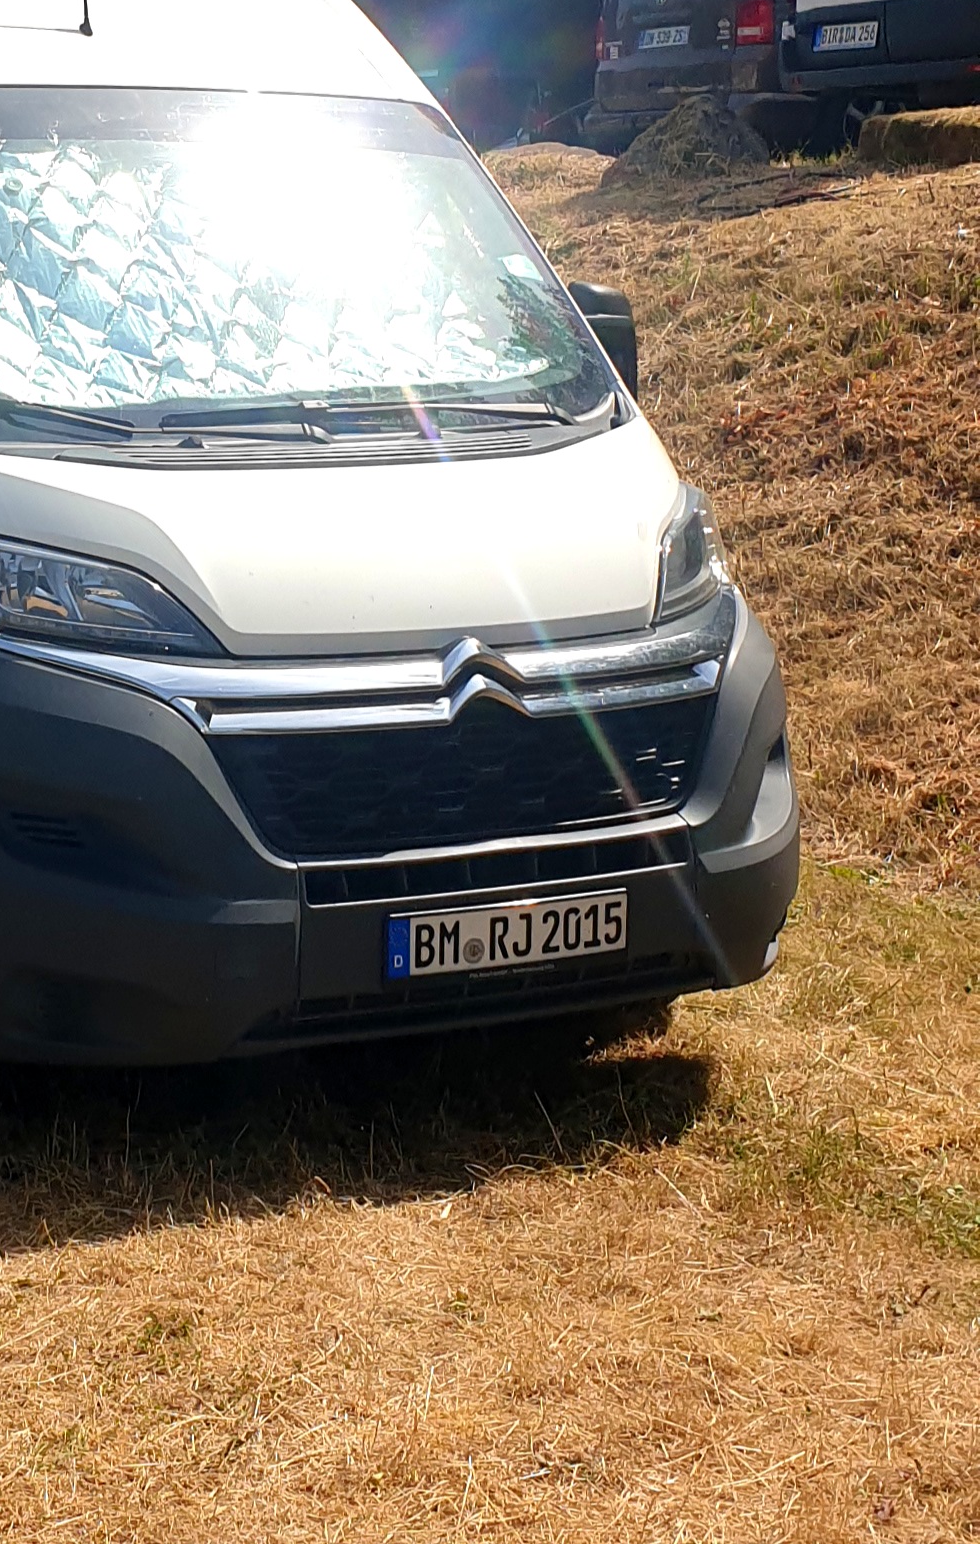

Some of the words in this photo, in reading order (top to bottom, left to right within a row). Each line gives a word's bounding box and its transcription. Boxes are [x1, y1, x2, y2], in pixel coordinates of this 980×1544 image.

[821, 29, 839, 44] BIR
[844, 26, 856, 43] DA
[858, 24, 875, 42] 256
[414, 920, 461, 969] BM
[489, 913, 533, 961] RJ
[541, 901, 622, 954] 2015
[394, 955, 403, 968] D
